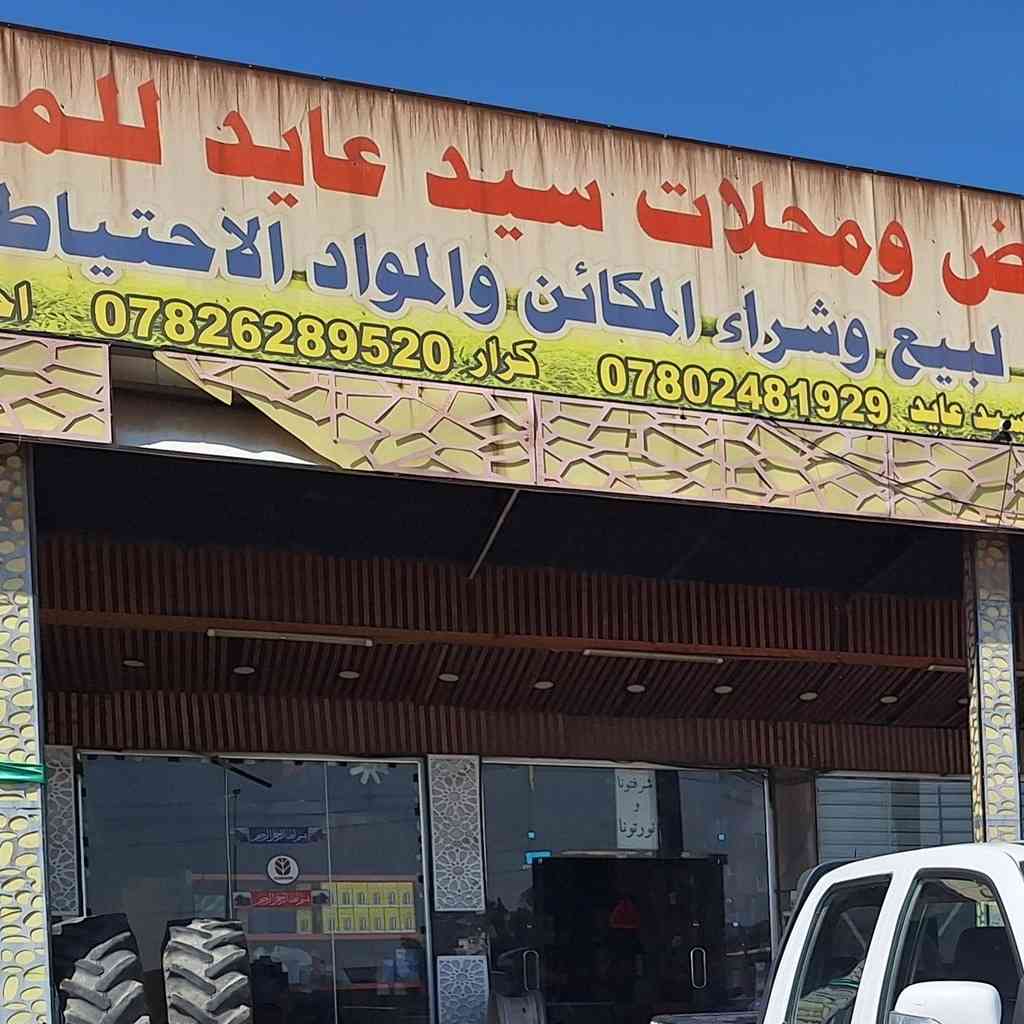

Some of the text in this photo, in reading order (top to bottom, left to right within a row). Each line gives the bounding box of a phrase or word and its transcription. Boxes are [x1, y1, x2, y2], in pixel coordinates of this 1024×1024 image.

[0, 73, 163, 166] للم
[205, 107, 387, 208] عايد
[426, 145, 604, 241] سيد
[636, 177, 914, 297] ومحلات
[0, 183, 1006, 388] لبيع وشراء المكائن والمواد الاحتياط
[90, 289, 456, 374] 07826289520
[470, 336, 540, 384] كرار
[597, 353, 891, 427] 07802481929
[908, 391, 964, 434] عايد
